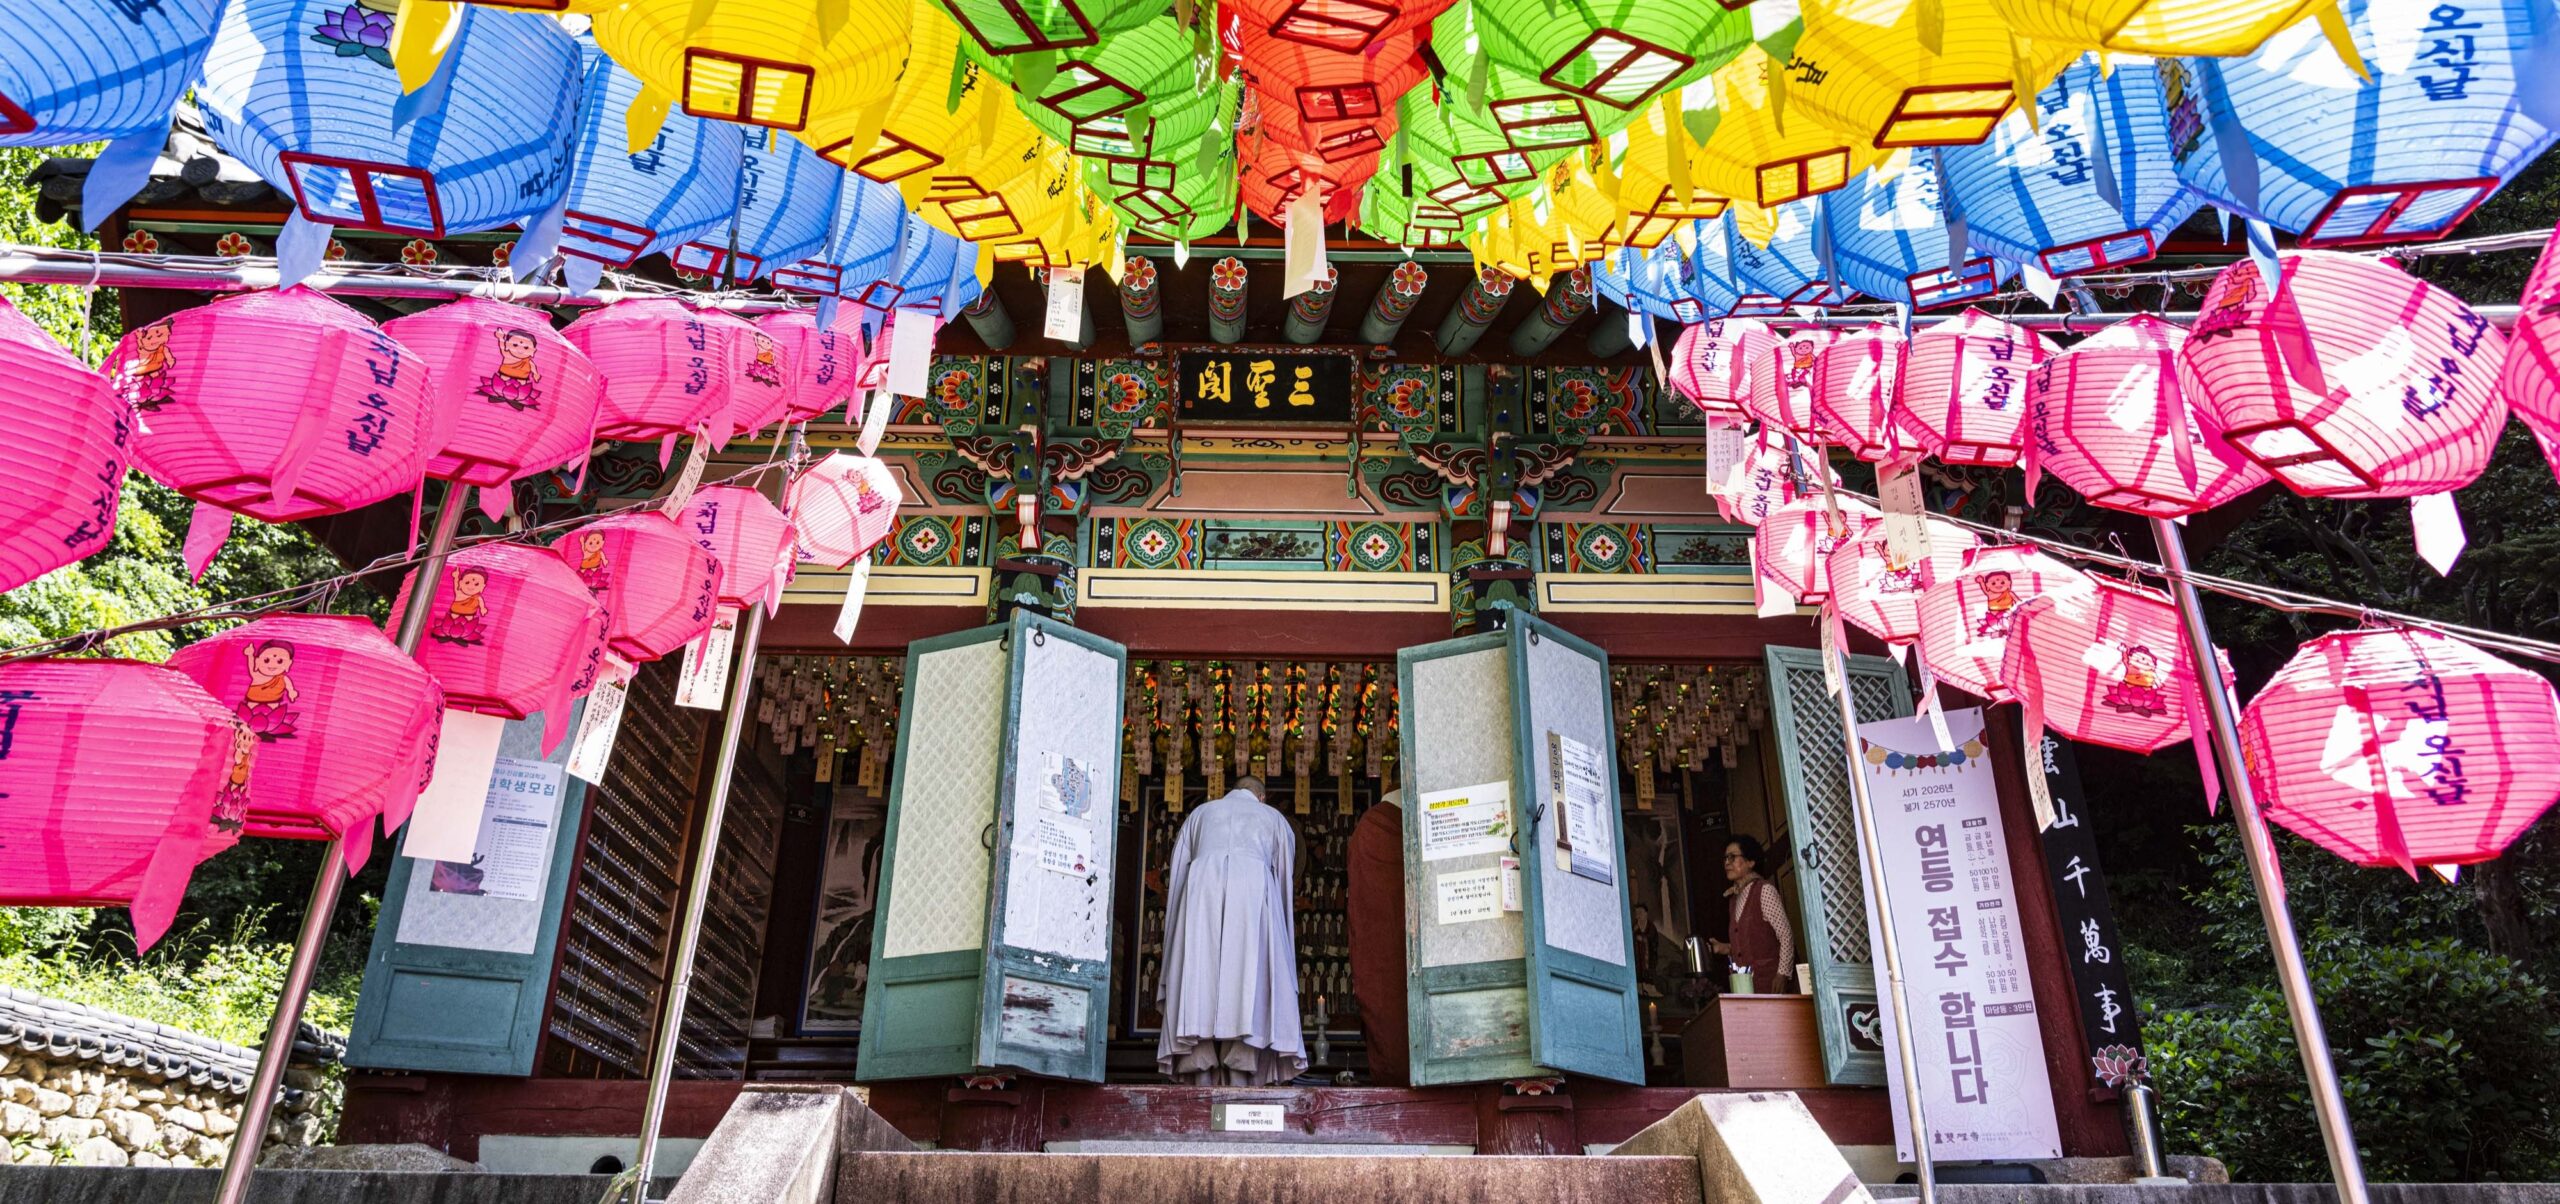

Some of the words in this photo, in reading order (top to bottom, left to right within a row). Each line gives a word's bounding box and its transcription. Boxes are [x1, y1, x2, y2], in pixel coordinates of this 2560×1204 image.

[2415, 4, 2484, 101] 오신날
[2041, 123, 2094, 187] 오신날
[346, 392, 395, 456] 오신날
[64, 459, 118, 549] 오신날
[1902, 785, 1918, 798] 서기
[1921, 783, 1954, 798] 2026년
[1904, 801, 1921, 813] 불기
[1924, 797, 1957, 811] 2570년
[2418, 735, 2473, 807] 오신날
[1915, 823, 1955, 893] 연등
[1927, 905, 1969, 977] 접수
[2012, 1002, 2033, 1013] 3만원
[1938, 991, 1989, 1105] 합니다
